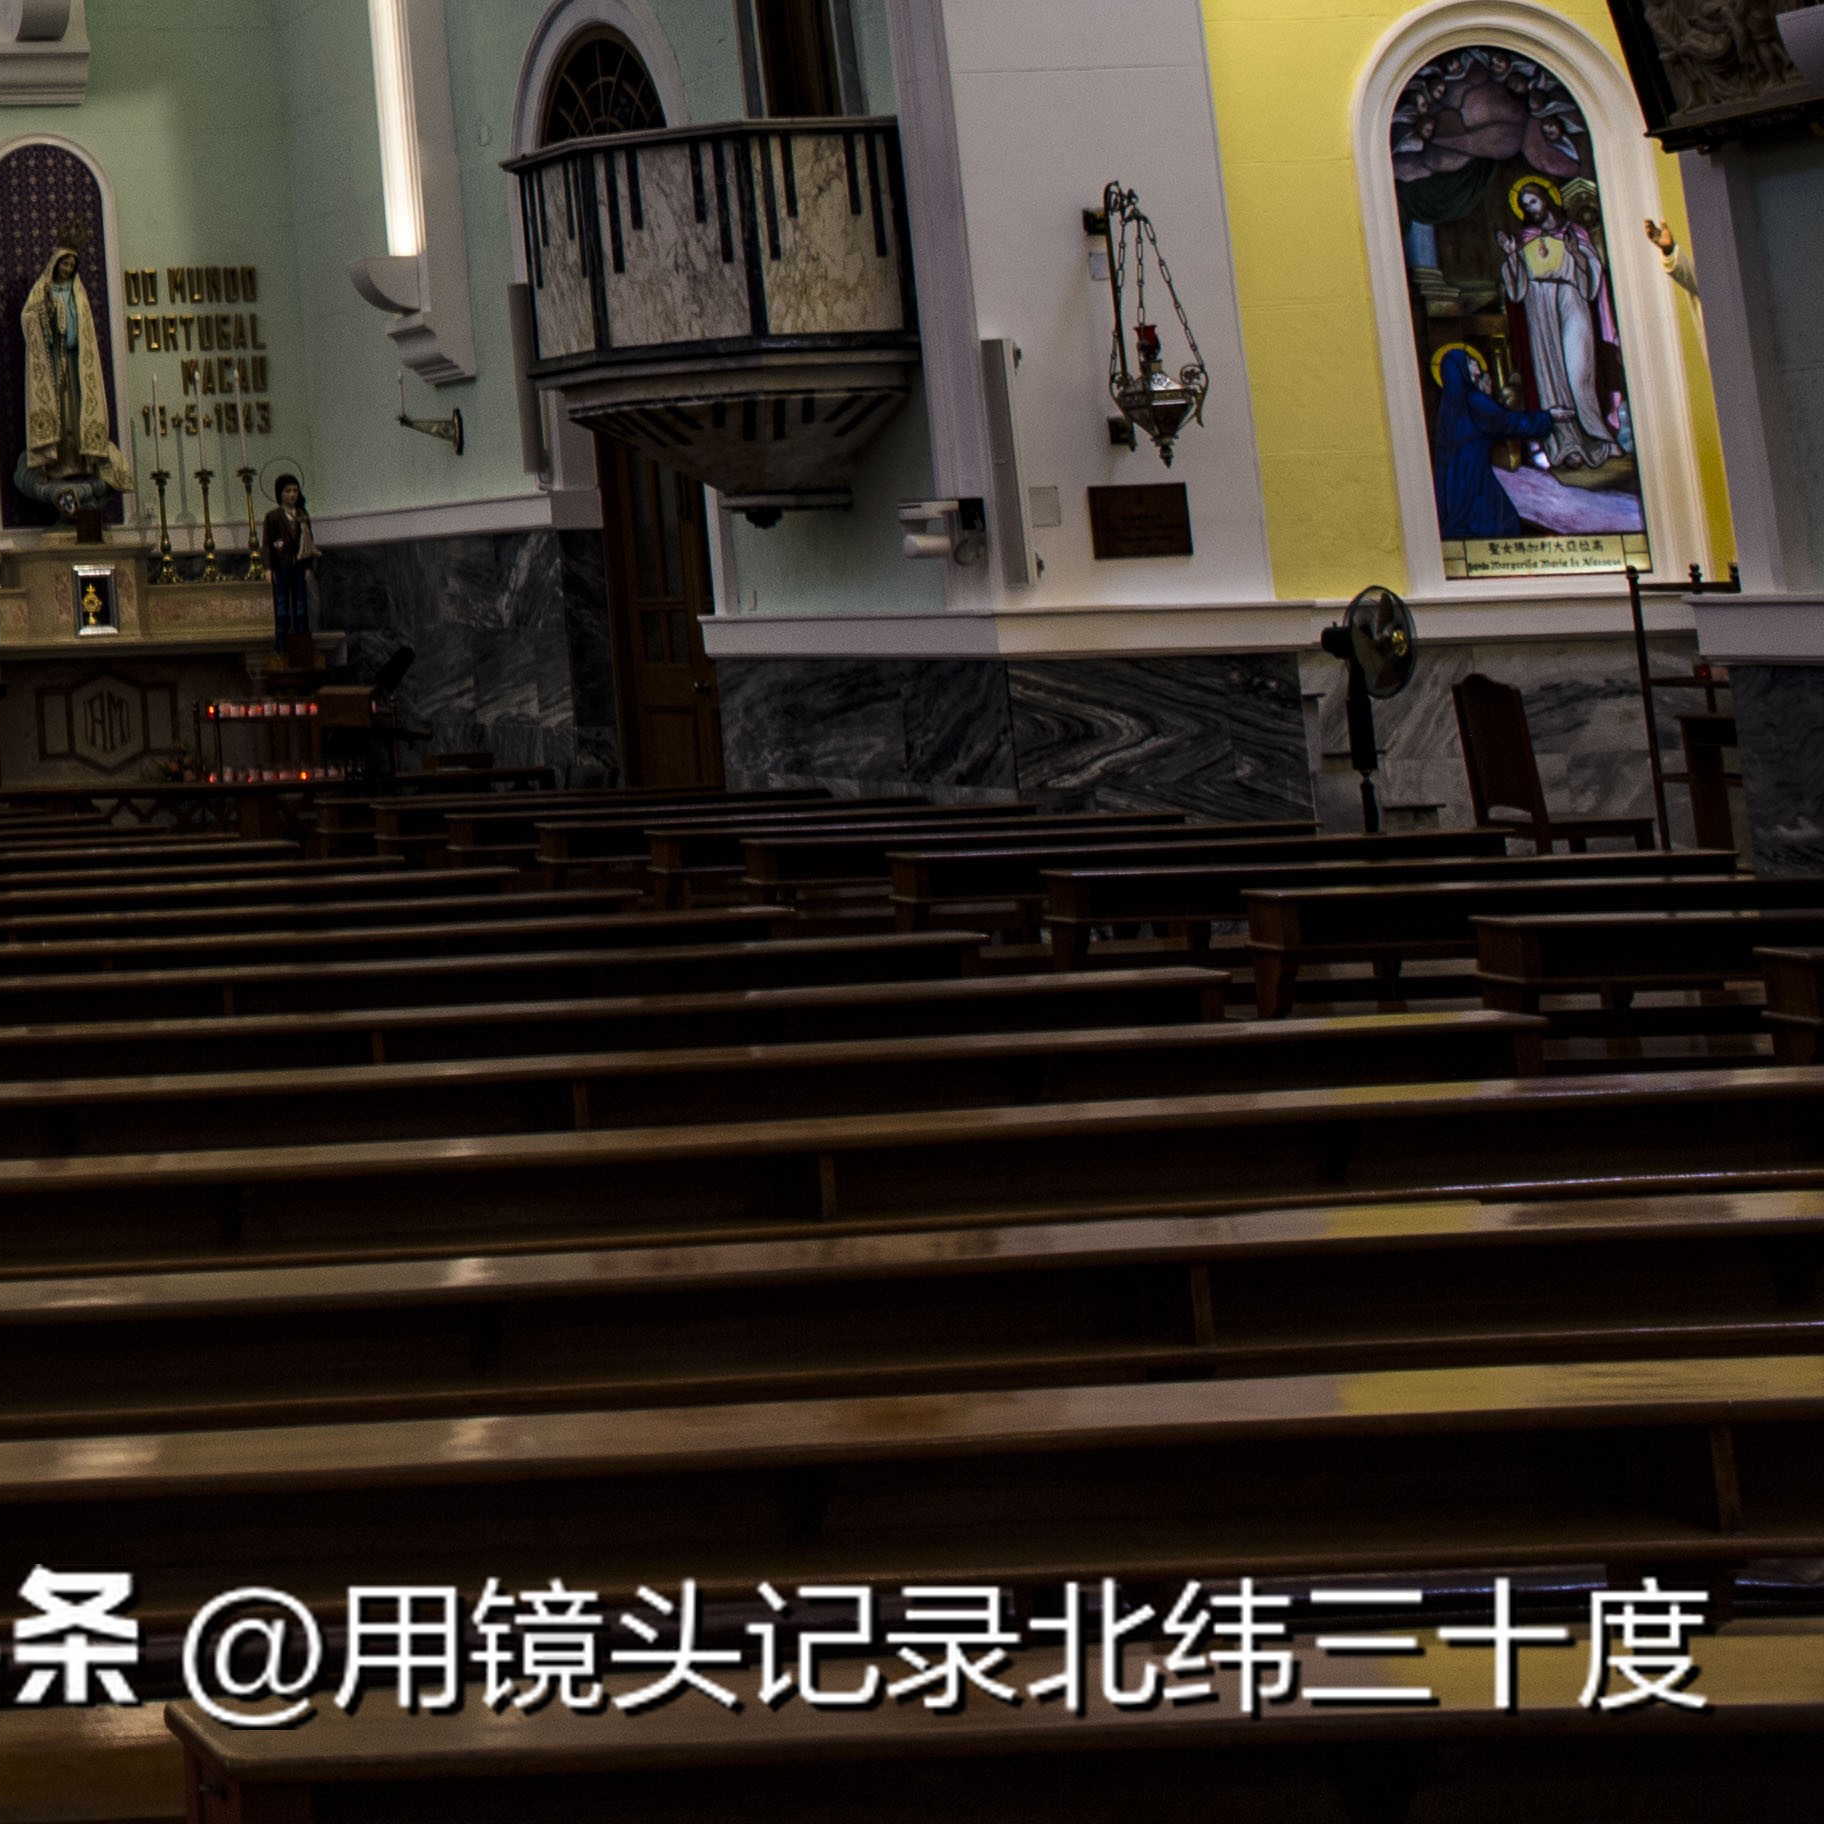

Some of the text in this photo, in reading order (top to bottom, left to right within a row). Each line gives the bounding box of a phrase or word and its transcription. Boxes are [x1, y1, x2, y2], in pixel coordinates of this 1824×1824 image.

[125, 266, 257, 306] DO MUNDO
[126, 313, 266, 353] PORTUGAL
[181, 356, 267, 396] MACAU
